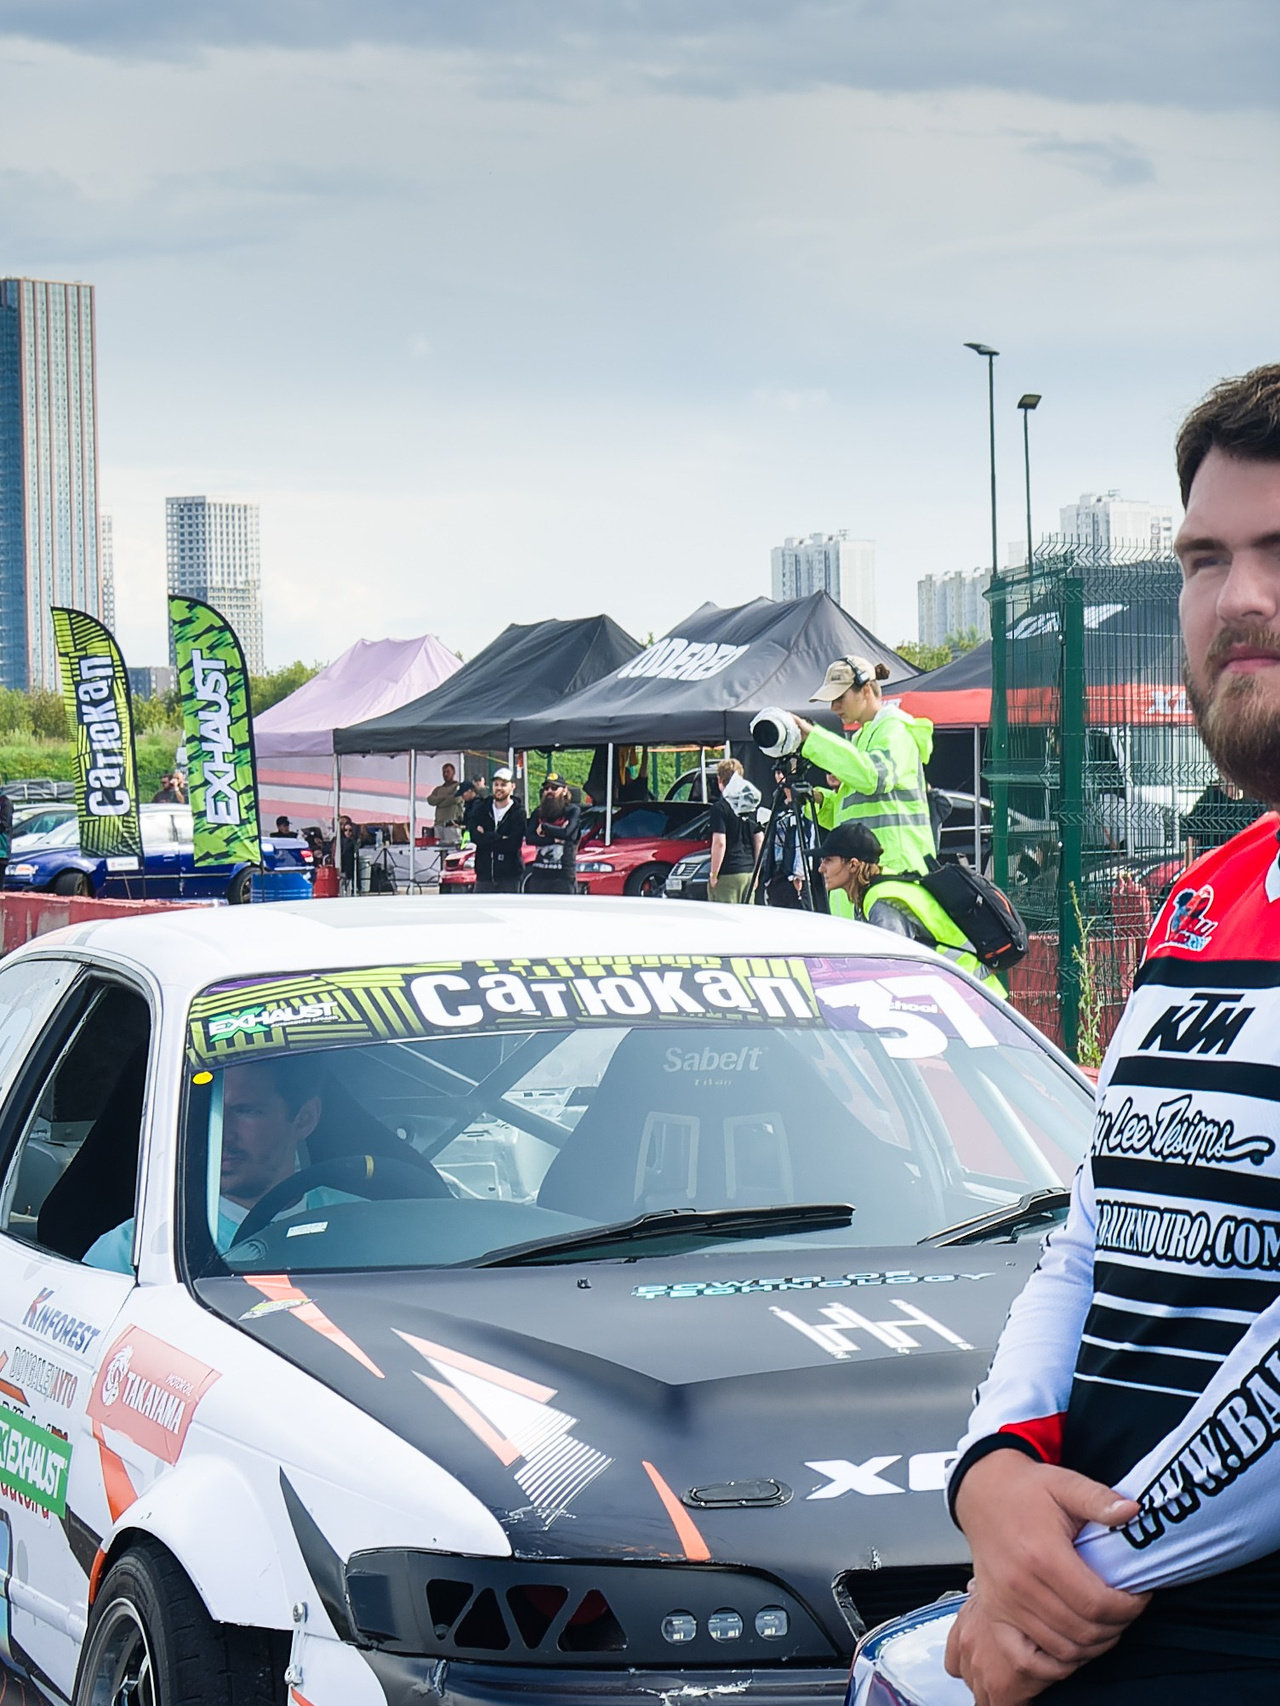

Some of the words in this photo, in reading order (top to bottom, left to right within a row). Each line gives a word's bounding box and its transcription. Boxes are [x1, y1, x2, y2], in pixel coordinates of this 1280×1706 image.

[191, 649, 241, 826] EXHAUST
[207, 1001, 338, 1038] EXHAUST
[1137, 992, 1256, 1056] KTM
[662, 1046, 763, 1073] Sabelt
[1108, 1096, 1153, 1155] Lee
[1149, 1093, 1275, 1166] Designs
[632, 1272, 997, 1300] TECHNOLOGY
[636, 1275, 826, 1294] POWER
[22, 1287, 101, 1354] KINFOREST
[122, 1373, 188, 1434] TAKAYAMA
[5, 1427, 67, 1500] EXHAUST
